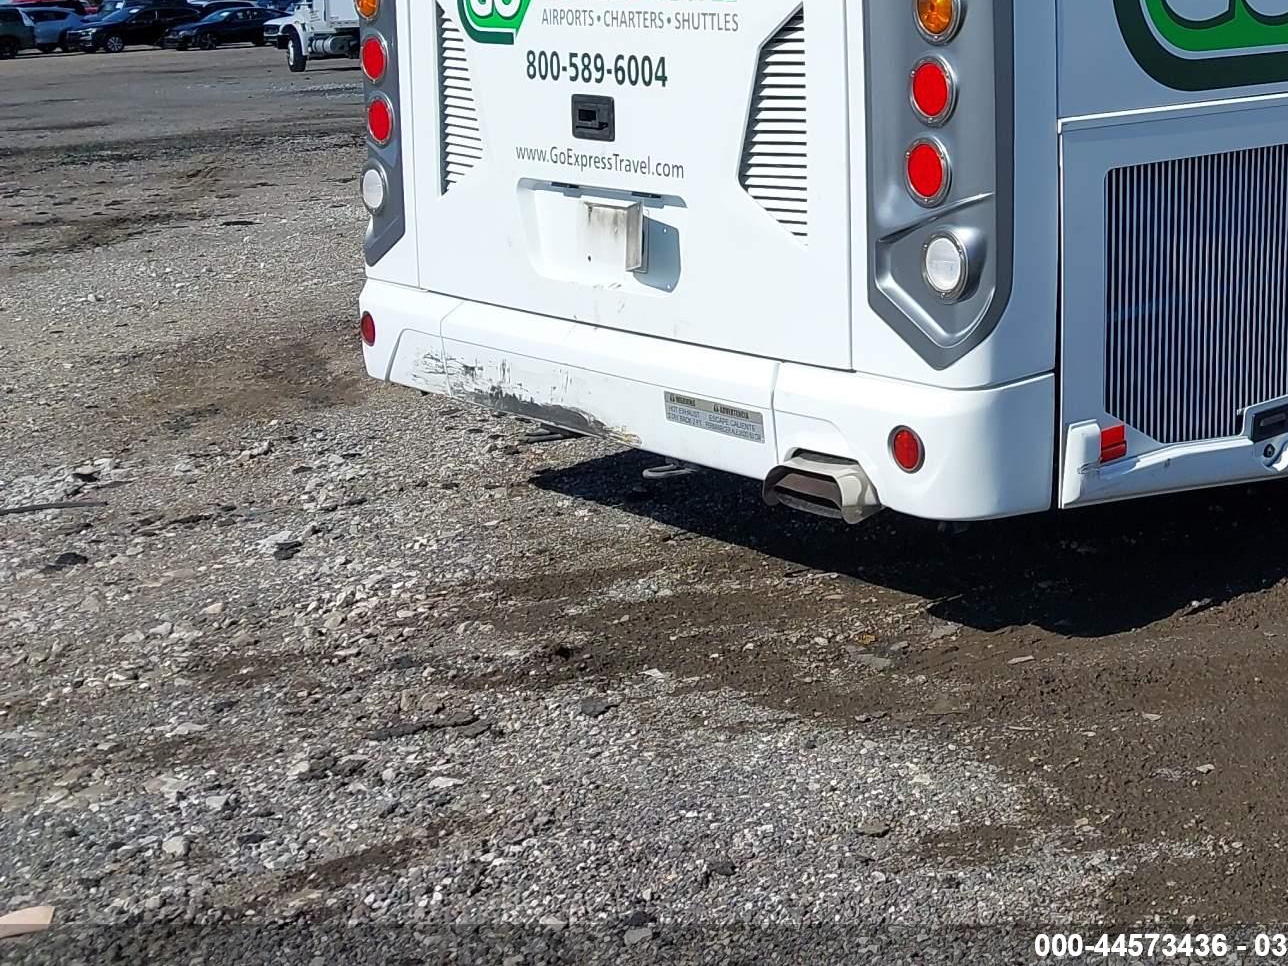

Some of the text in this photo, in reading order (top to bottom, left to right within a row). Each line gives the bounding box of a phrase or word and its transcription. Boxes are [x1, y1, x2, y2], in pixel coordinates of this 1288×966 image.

[541, 8, 739, 32] AIRPORTS CHARTERS SHUTTLES
[525, 50, 668, 87] 800-589-6004
[515, 145, 684, 179] www.GoExpressTravel.com
[708, 414, 757, 432] ESCAPE CALIENTE
